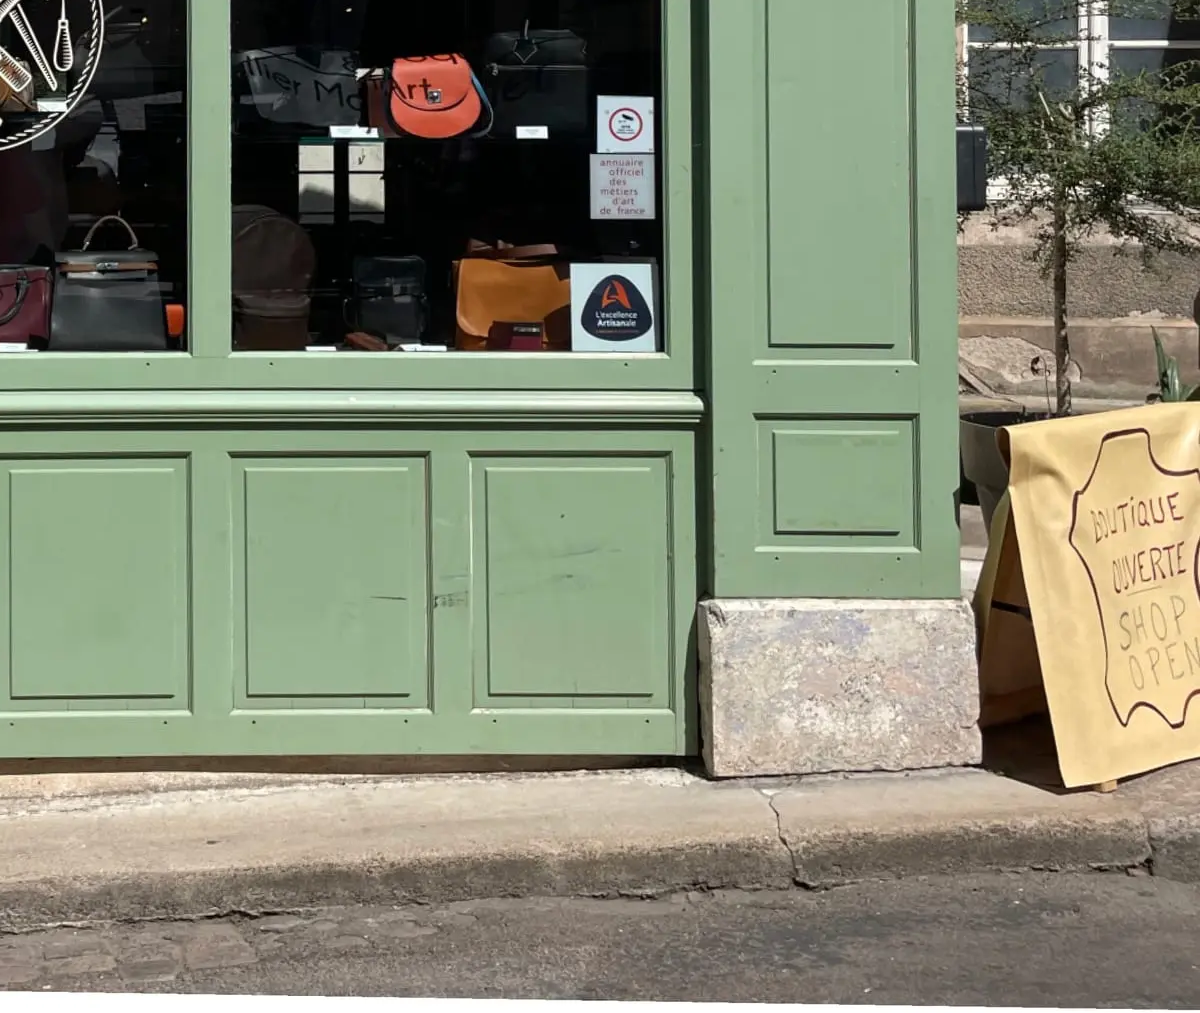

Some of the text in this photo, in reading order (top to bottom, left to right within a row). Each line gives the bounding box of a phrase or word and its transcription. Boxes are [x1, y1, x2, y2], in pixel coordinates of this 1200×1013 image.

[600, 159, 643, 167] annuaire
[609, 167, 643, 177] officiel
[609, 178, 627, 186] des
[599, 207, 645, 215] de france
[597, 319, 637, 328] Artisanale
[1113, 541, 1187, 593] OUVERTE
[1119, 595, 1186, 651] SHOP
